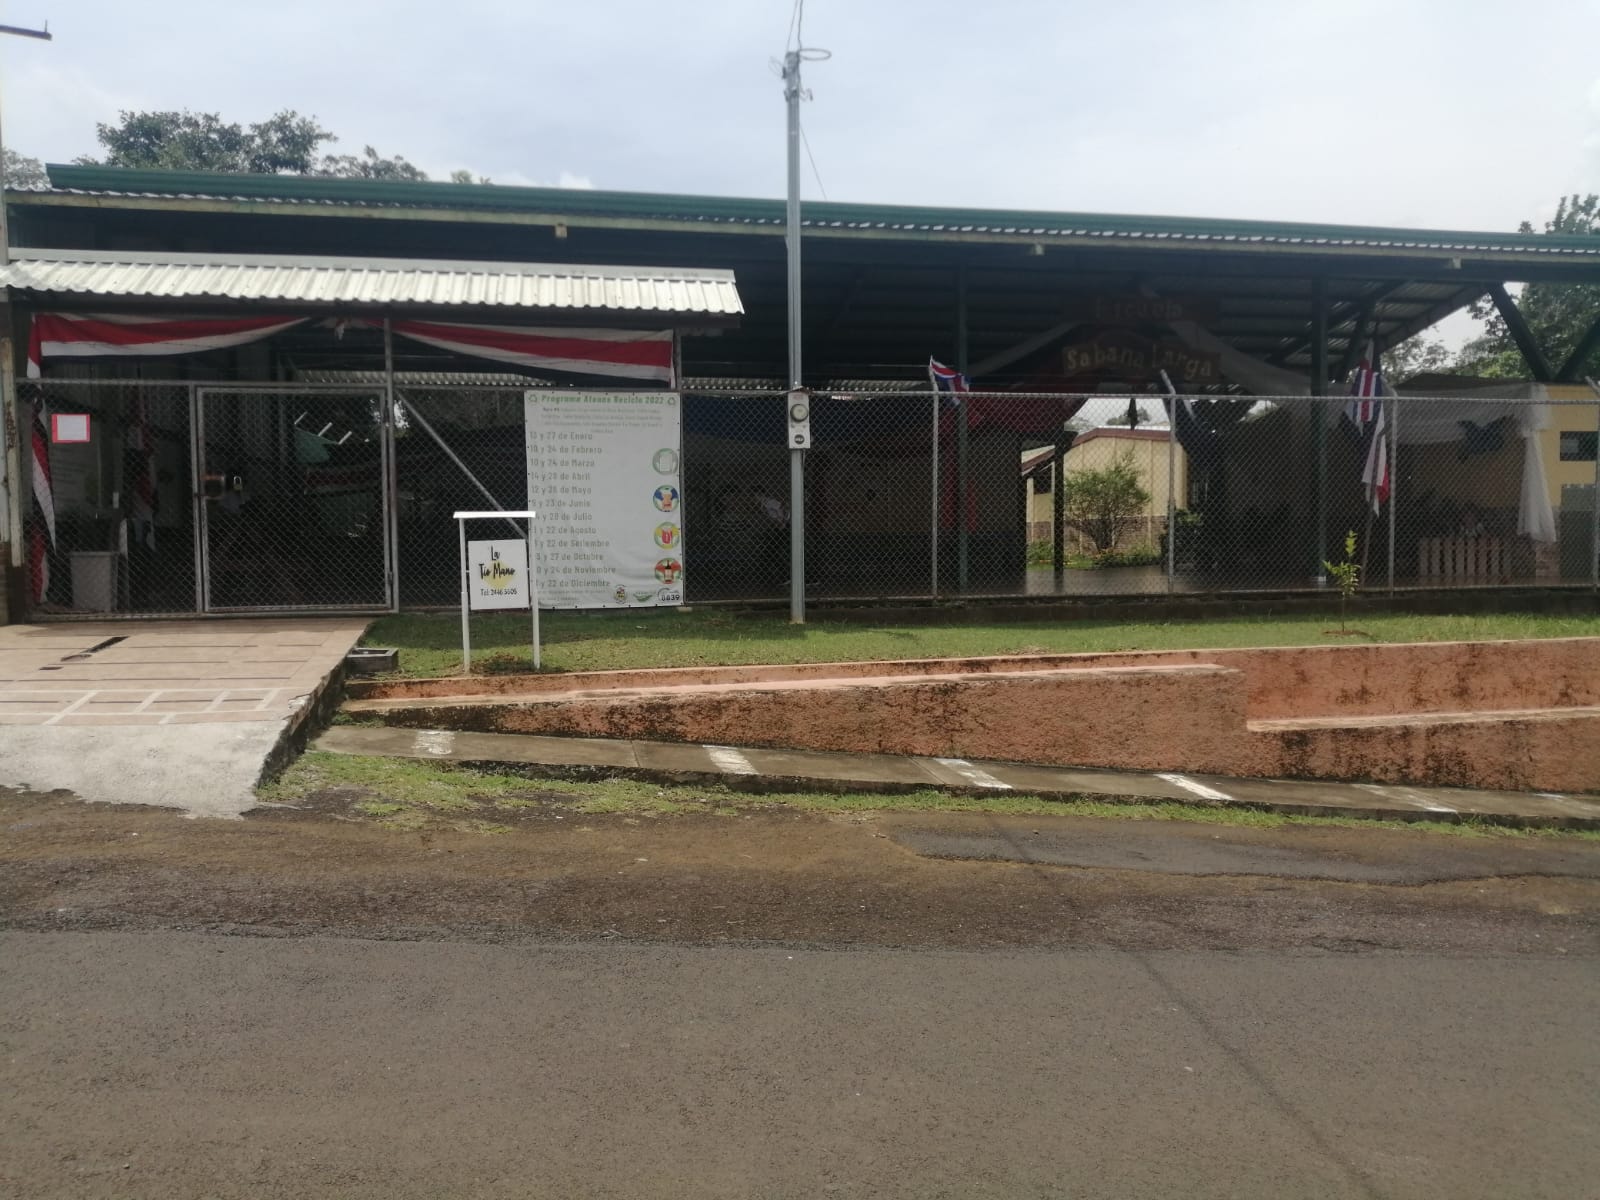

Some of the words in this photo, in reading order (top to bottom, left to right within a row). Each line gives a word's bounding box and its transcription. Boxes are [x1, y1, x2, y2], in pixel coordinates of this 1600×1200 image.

[1066, 343, 1145, 371] Sabana
[1152, 343, 1212, 379] Larga
[541, 394, 581, 405] Programa
[645, 396, 664, 404] 2022
[558, 432, 568, 440] de
[570, 432, 593, 440] Enero
[560, 445, 569, 453] de
[571, 445, 602, 453] Febrero
[560, 458, 569, 466] de
[571, 459, 595, 467] Marzo
[560, 472, 569, 480] de
[572, 472, 591, 480] Abril
[560, 485, 569, 494] de
[571, 486, 592, 495] Mayo
[557, 499, 566, 507] de
[569, 499, 591, 507] Junio
[561, 512, 570, 520] de
[572, 512, 593, 520] Julio
[558, 526, 568, 534] de
[570, 526, 597, 535] Agosto
[558, 540, 568, 548] de
[562, 552, 571, 560] de
[573, 552, 603, 560] Octubre
[562, 566, 572, 574] de
[574, 566, 616, 574] Noviembre
[560, 579, 569, 587] de
[571, 579, 611, 588] Diciembre
